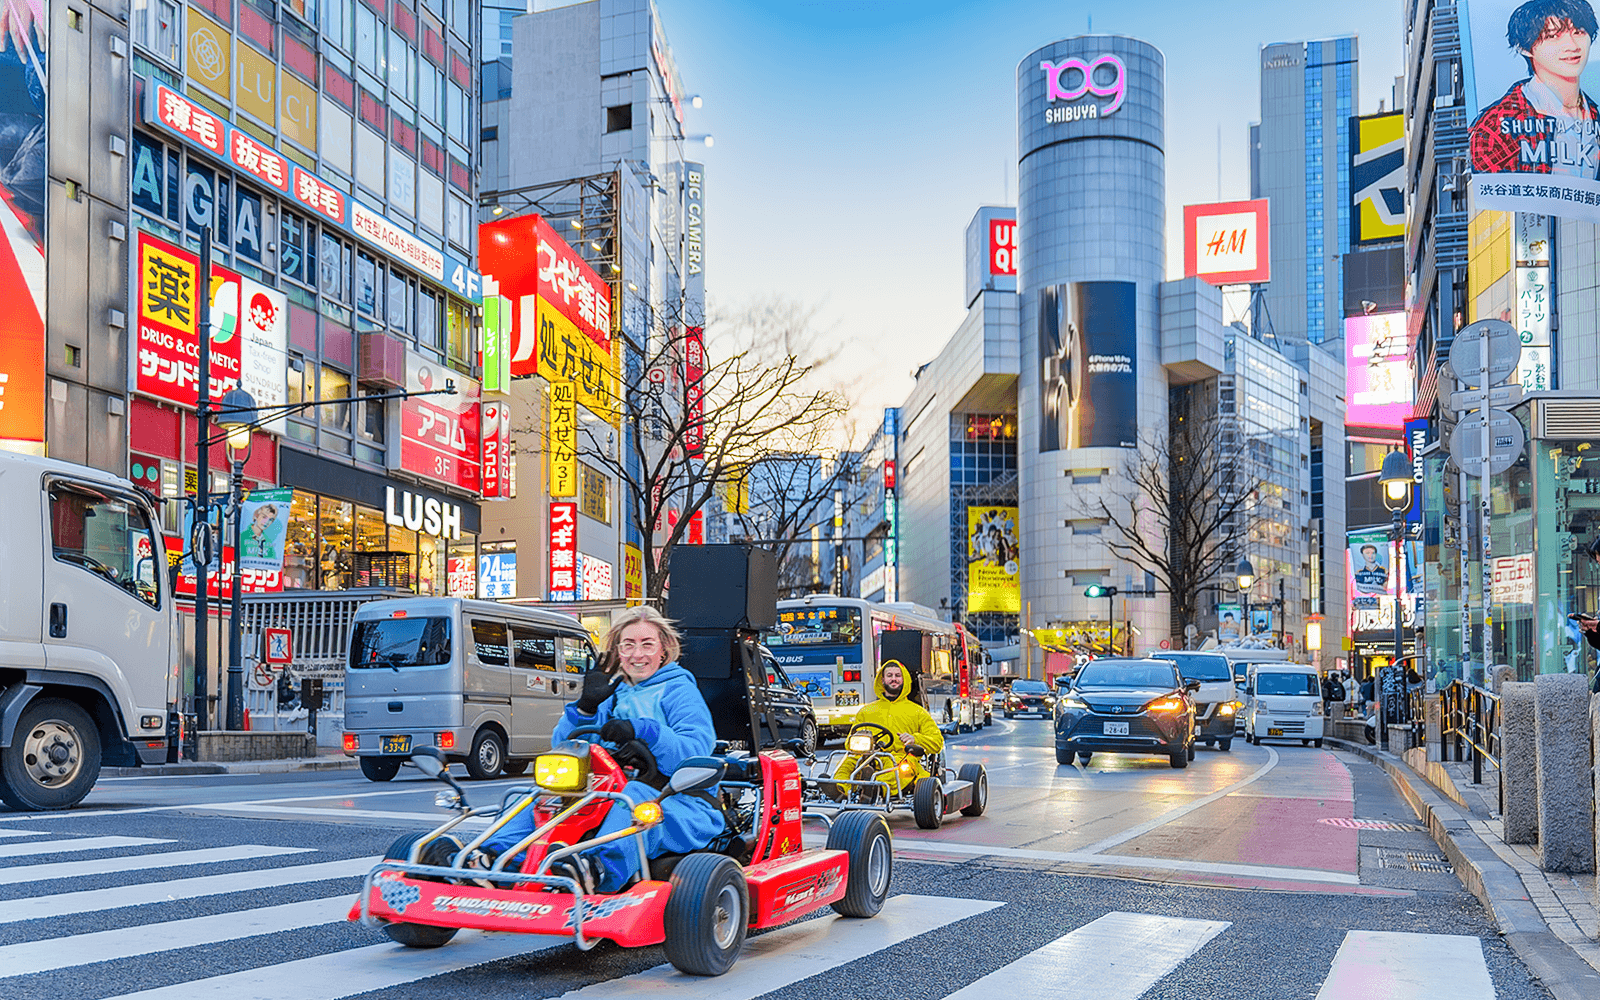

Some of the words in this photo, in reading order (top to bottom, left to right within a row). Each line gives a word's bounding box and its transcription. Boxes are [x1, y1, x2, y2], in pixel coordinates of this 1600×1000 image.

[1263, 58, 1300, 69] INDIGO
[1040, 54, 1126, 118] 109
[163, 93, 219, 150] 薄毛
[1045, 104, 1097, 123] SHIBUYA
[1500, 117, 1566, 134] SHUNTA
[235, 135, 283, 187] 抜毛
[299, 171, 339, 219] 発毛
[688, 170, 702, 199] BIC
[688, 202, 702, 275] CAMERA
[1206, 229, 1247, 256] H&M
[148, 256, 190, 325] 薬
[451, 264, 479, 298] 4F
[1521, 289, 1532, 328] パーラー
[1534, 283, 1545, 323] フルーツ
[141, 326, 174, 349] DRUG
[175, 338, 185, 352] &
[185, 342, 239, 373] COMETIC
[250, 332, 273, 348] Japan
[485, 327, 496, 358] レイク
[253, 359, 271, 375] Shop
[540, 312, 610, 407] 処方せん
[245, 372, 283, 394] SUNDRUG
[417, 404, 466, 452] アコム
[554, 385, 572, 462] 処方せん
[434, 455, 450, 477] 3F
[485, 441, 497, 478] アコム
[1413, 430, 1426, 484] MIZUHO
[486, 481, 496, 490] 3F
[385, 485, 461, 541] LUSH
[551, 505, 575, 589] スギ薬局
[455, 559, 472, 573] 2F
[480, 555, 501, 583] 24
[485, 583, 511, 597] 営業
[786, 655, 804, 663] BUS
[388, 743, 409, 752] 33-41
[432, 895, 554, 916] STANDARDMOTO
